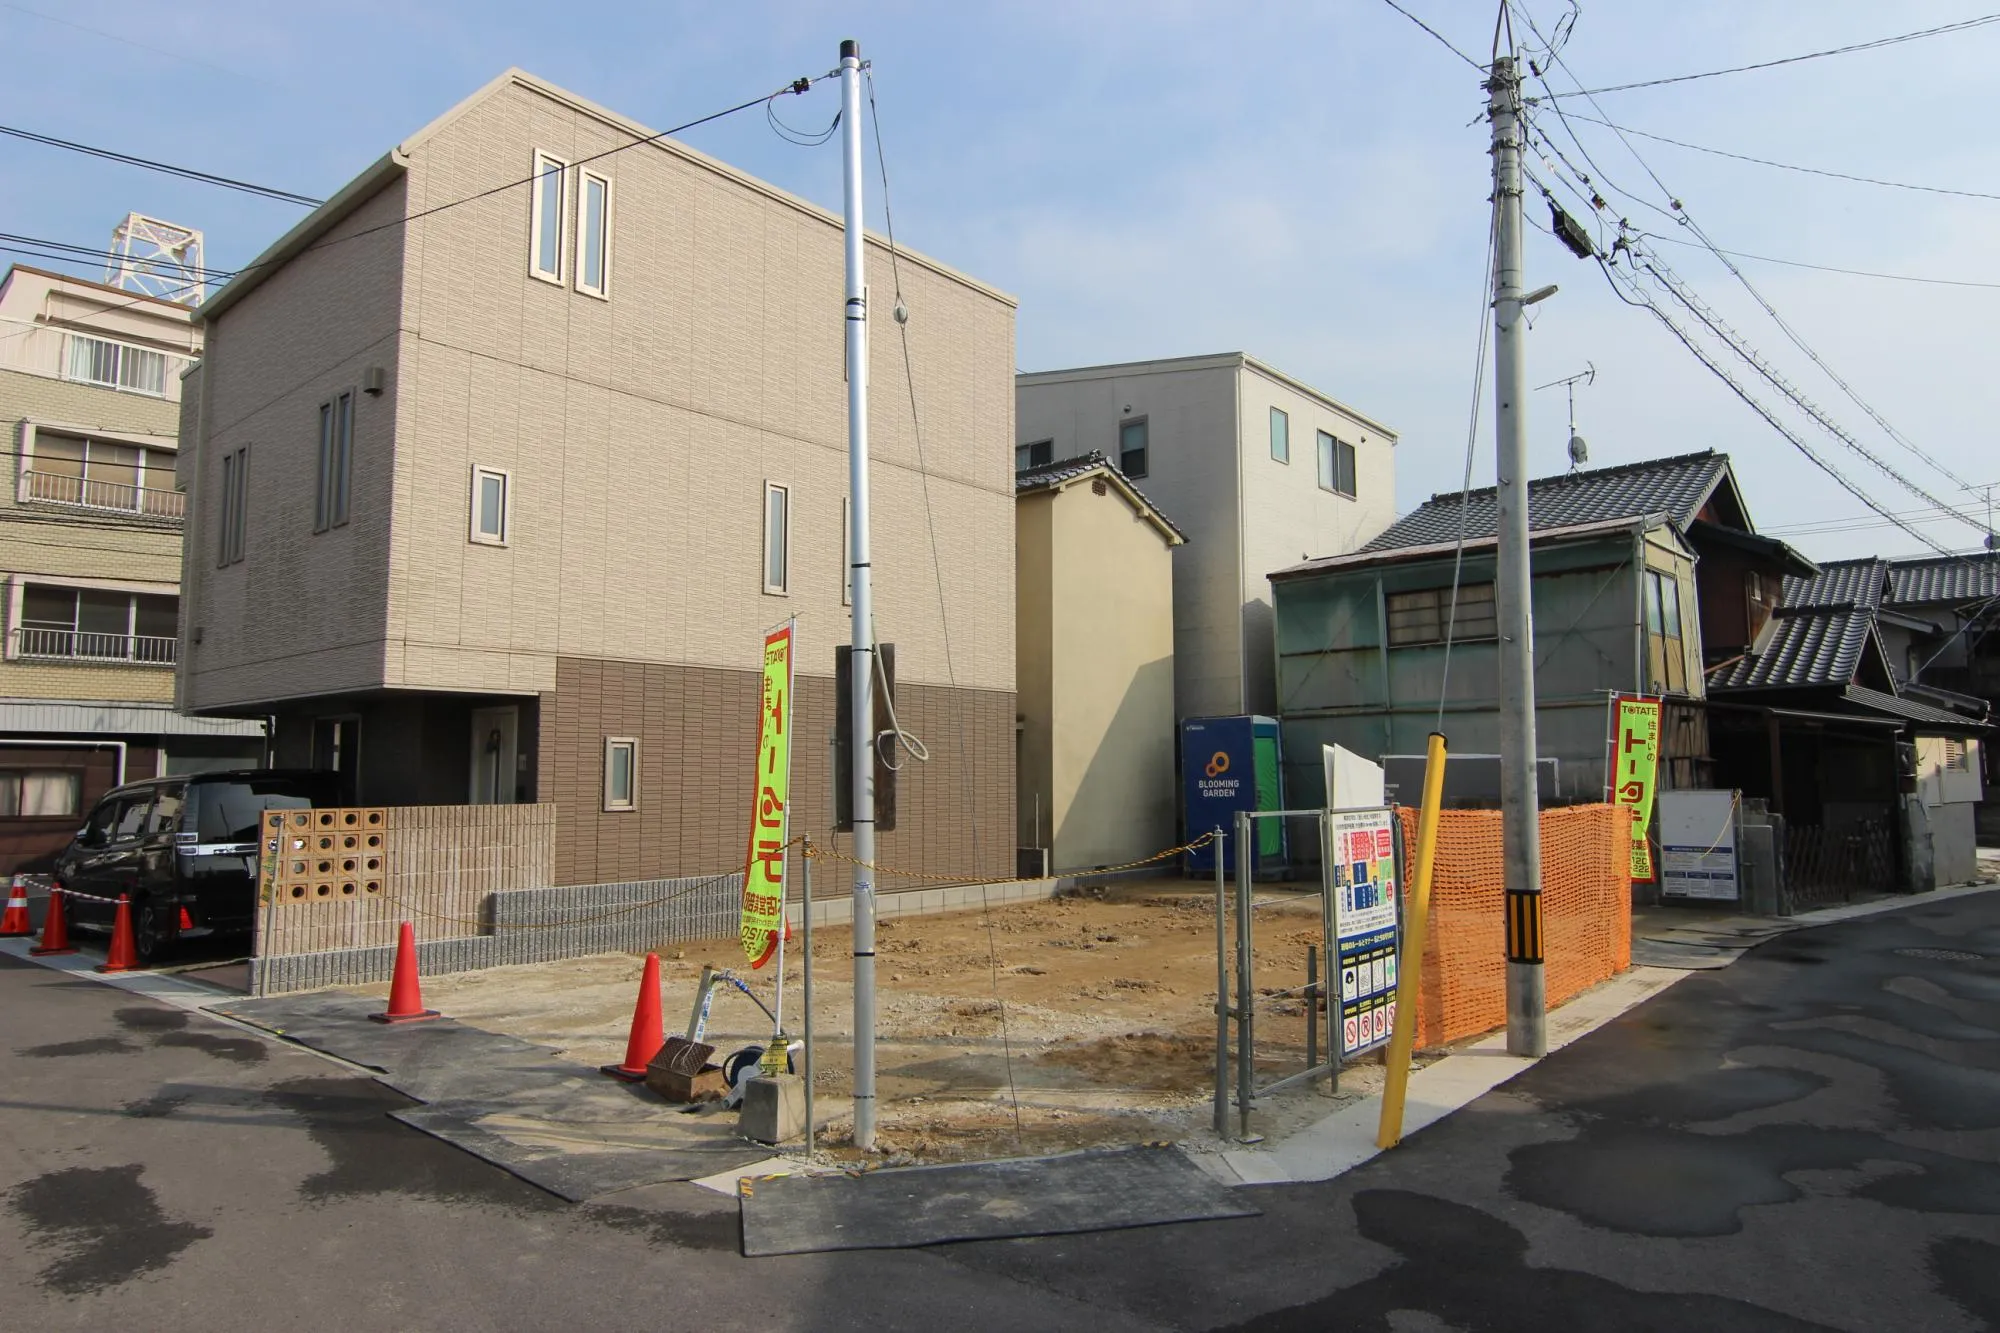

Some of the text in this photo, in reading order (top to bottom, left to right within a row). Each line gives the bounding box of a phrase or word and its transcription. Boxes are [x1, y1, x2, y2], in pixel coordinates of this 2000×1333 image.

[1622, 705, 1657, 715] TOTATE
[1646, 720, 1657, 762] 住まいの
[1198, 780, 1240, 788] BLOOMING
[1203, 789, 1235, 797] GARDEN
